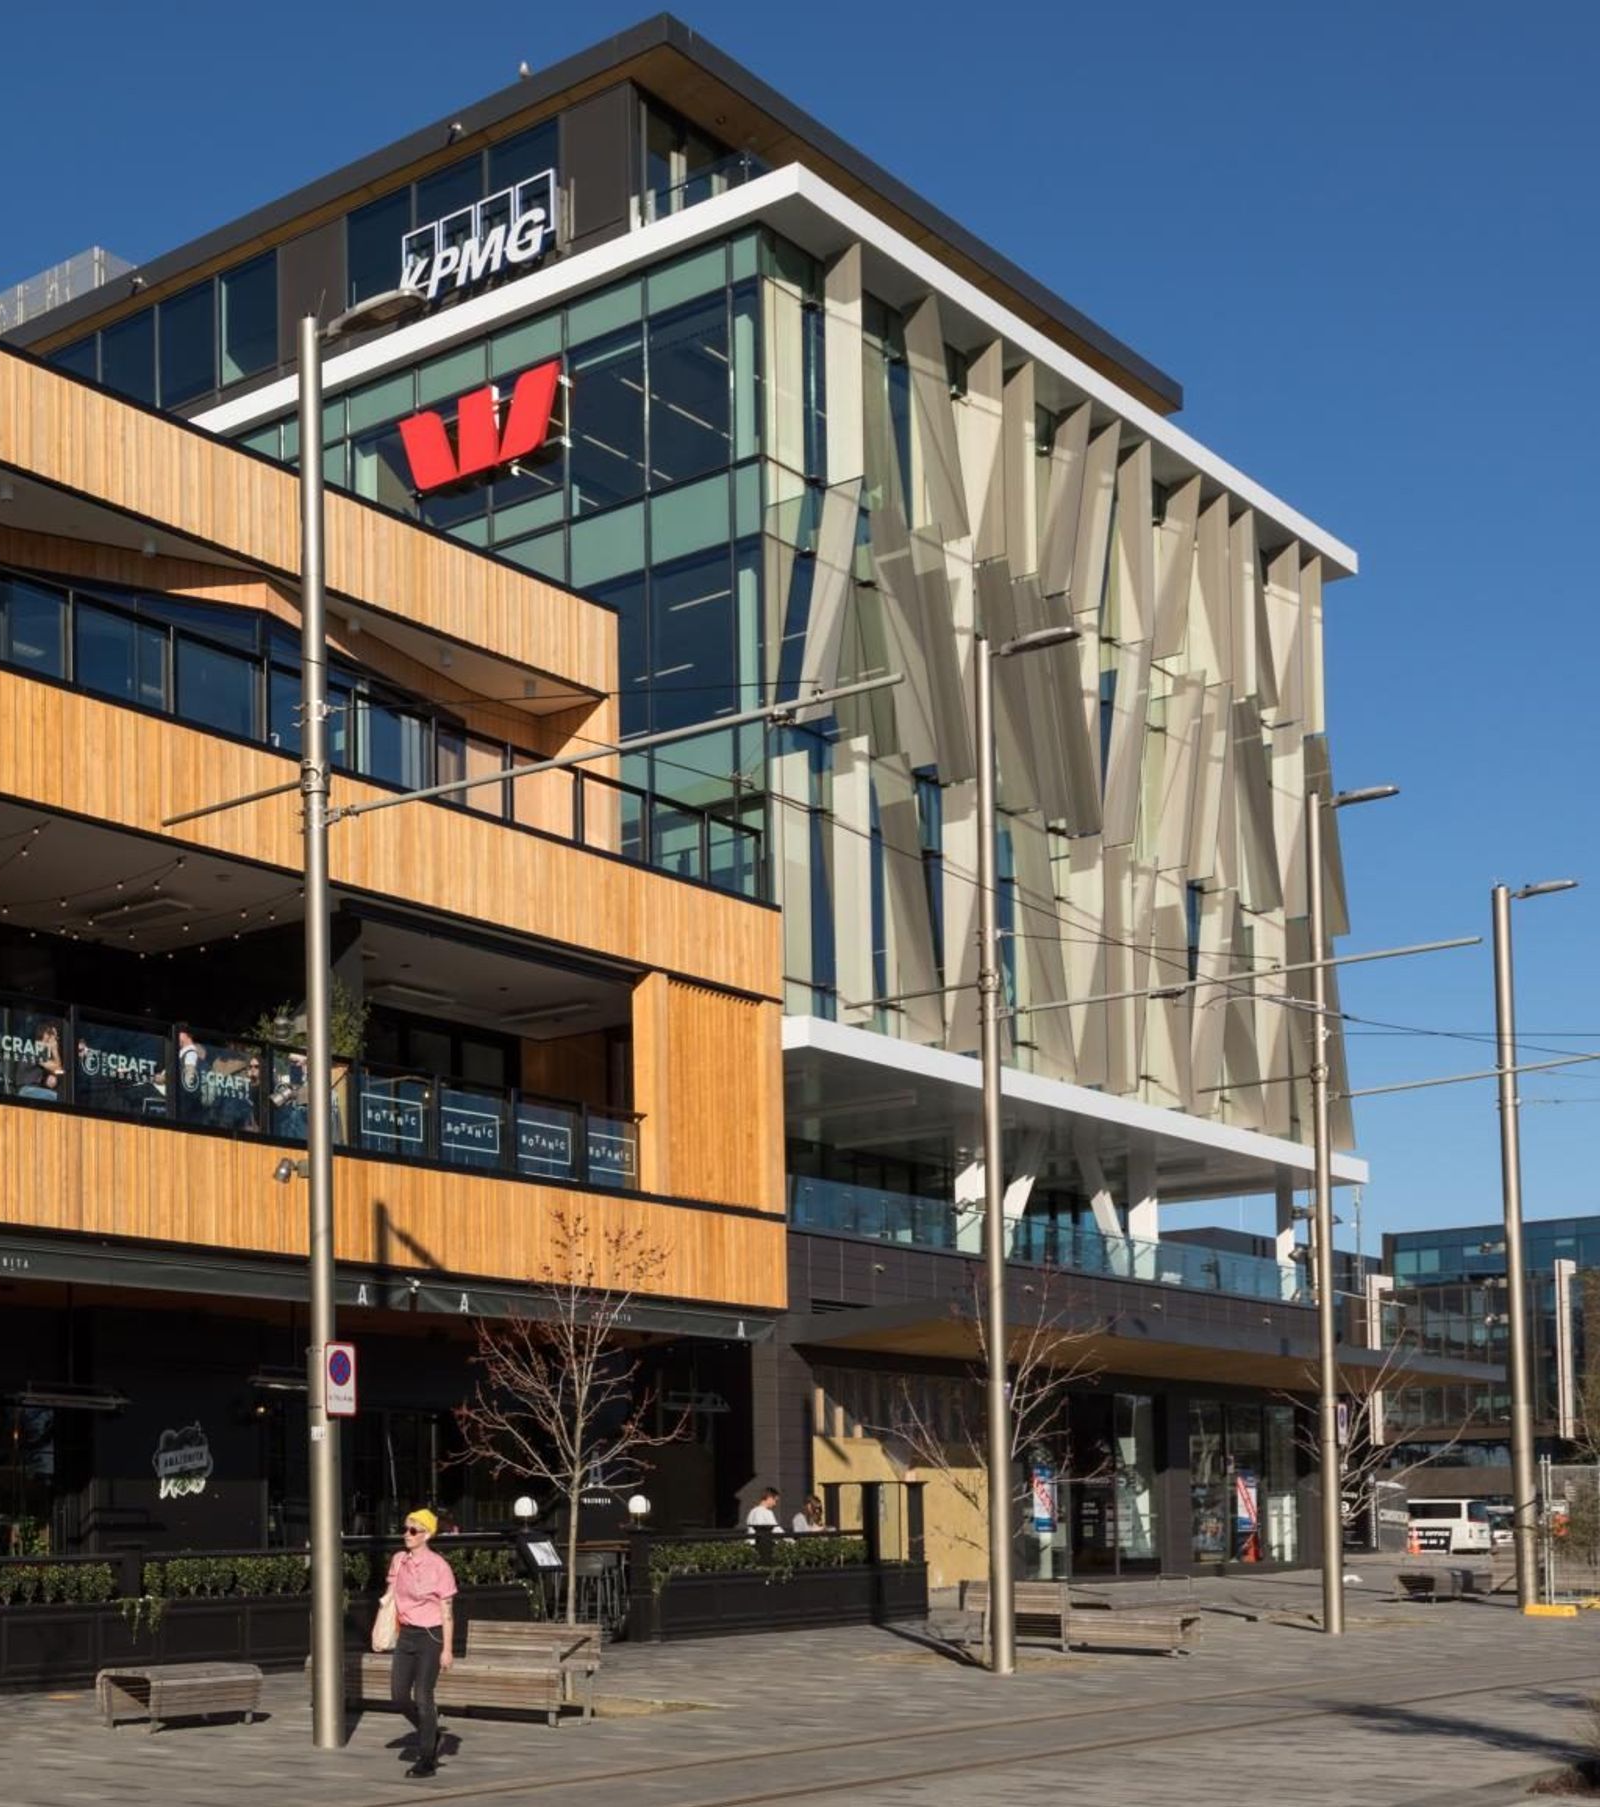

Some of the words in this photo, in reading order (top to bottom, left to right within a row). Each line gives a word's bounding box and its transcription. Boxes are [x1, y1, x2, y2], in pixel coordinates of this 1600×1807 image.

[399, 207, 548, 299] KPMG
[1, 1035, 51, 1058] CRAFT
[108, 1053, 157, 1076] CRAFT
[207, 1070, 252, 1094] CRAFT
[367, 1109, 416, 1126] BOTANIC
[446, 1122, 493, 1138] BOTANIC
[522, 1134, 565, 1150] BOTANIC
[588, 1146, 631, 1162] BOTANIC
[357, 1283, 368, 1307] A
[458, 1293, 470, 1314] A
